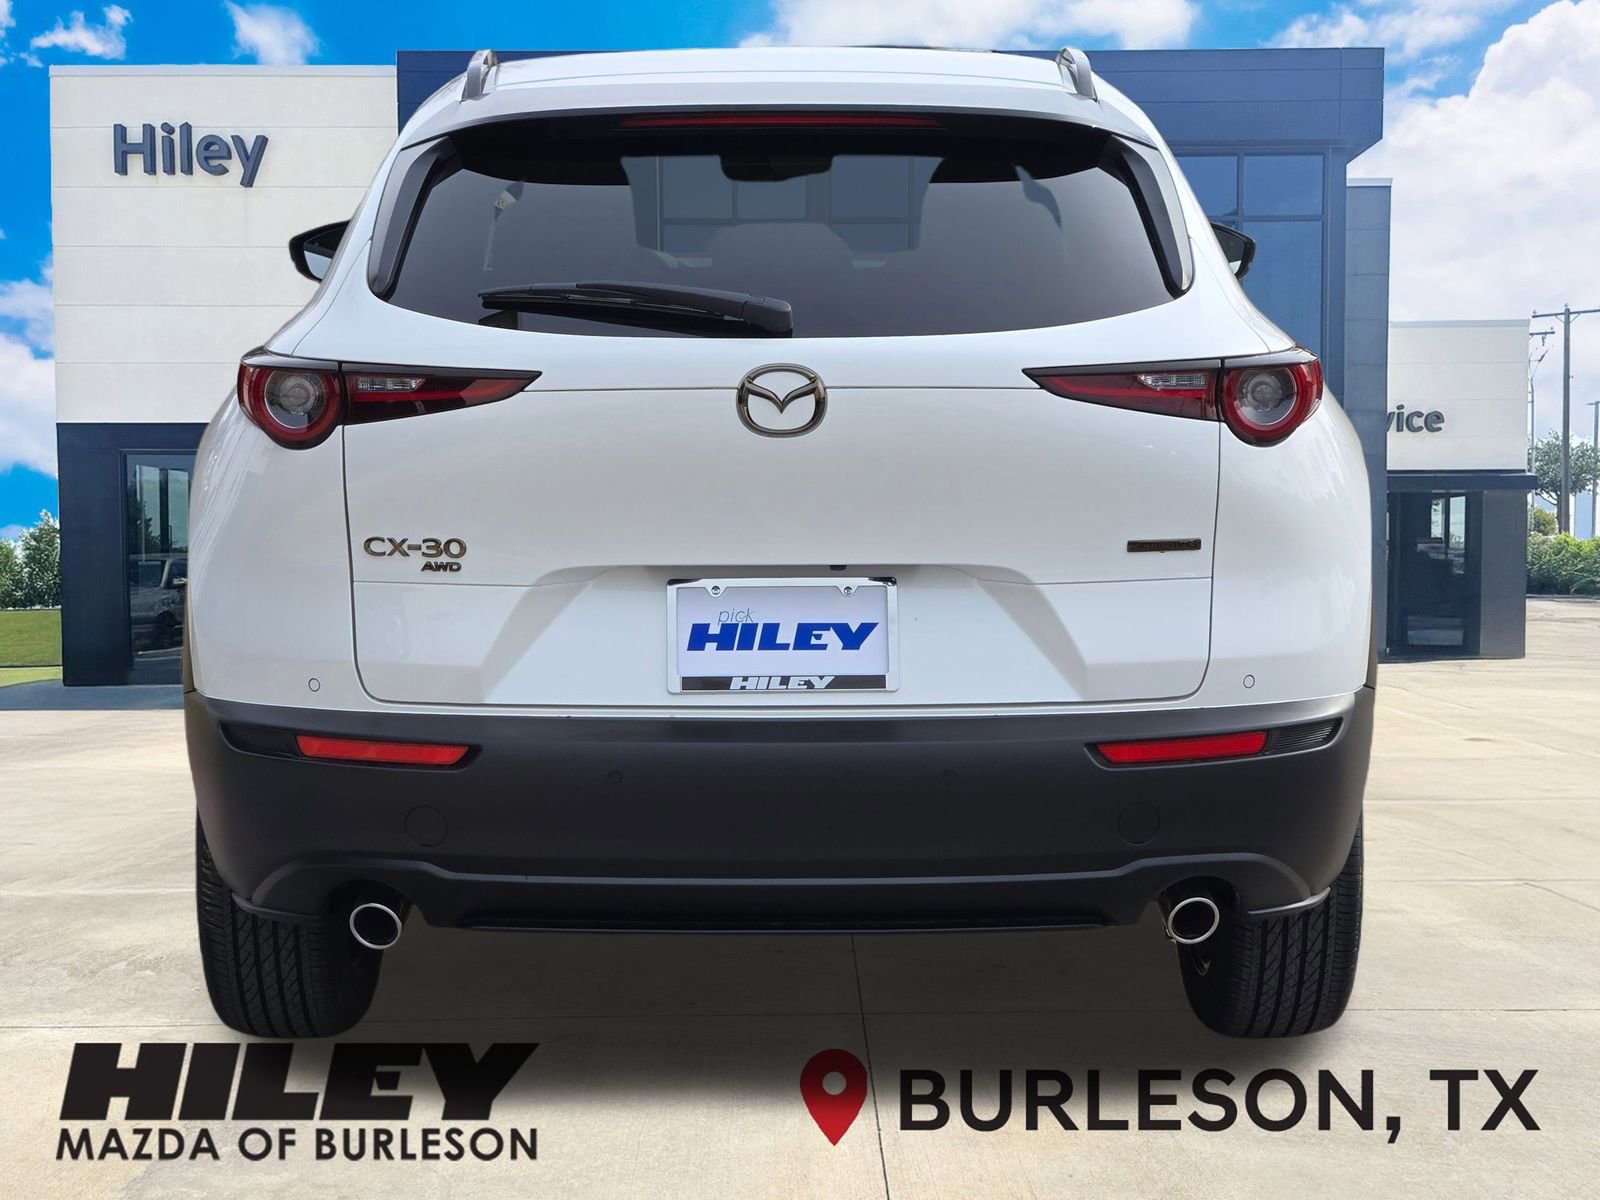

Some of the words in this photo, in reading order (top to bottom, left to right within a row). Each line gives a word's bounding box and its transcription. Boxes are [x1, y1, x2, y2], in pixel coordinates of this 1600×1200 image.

[113, 121, 269, 188] Hiley
[363, 536, 467, 559] CX-30
[420, 561, 462, 572] AWD
[717, 608, 757, 626] pick
[686, 622, 880, 652] HILEY
[729, 675, 836, 690] HILEY
